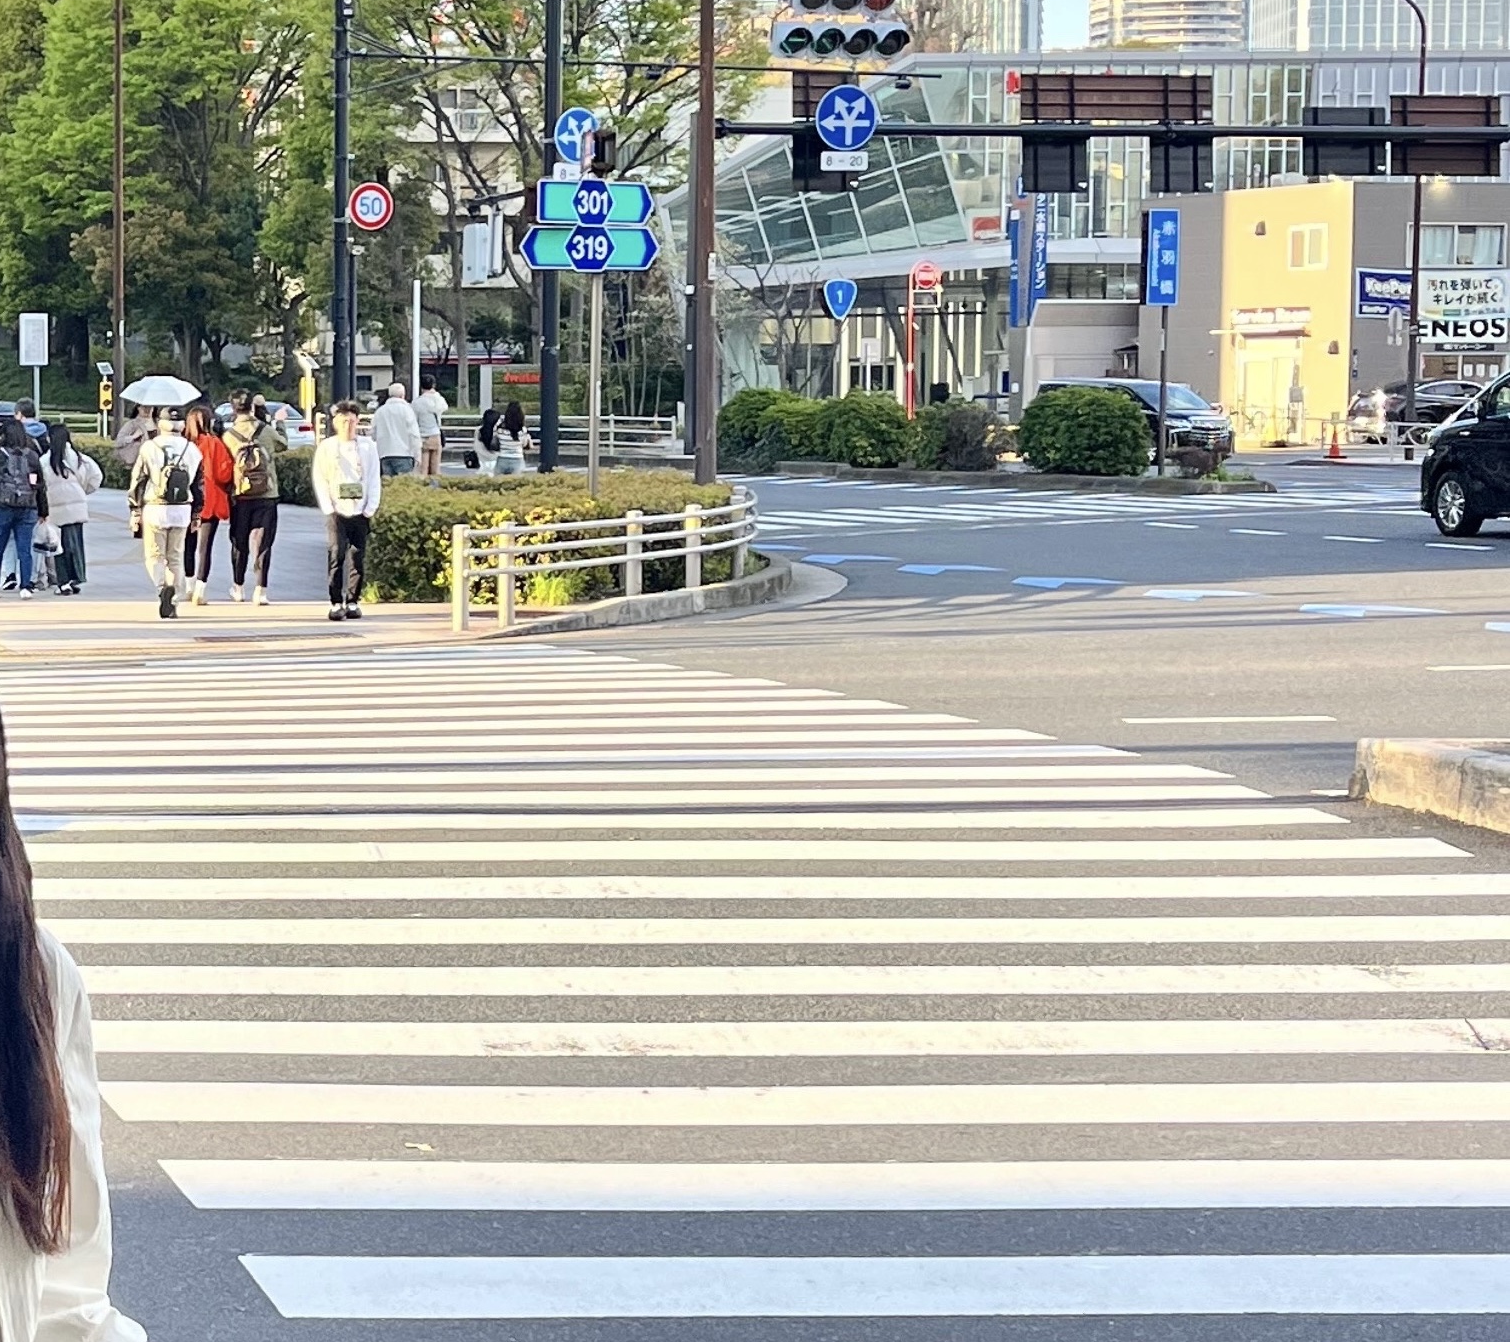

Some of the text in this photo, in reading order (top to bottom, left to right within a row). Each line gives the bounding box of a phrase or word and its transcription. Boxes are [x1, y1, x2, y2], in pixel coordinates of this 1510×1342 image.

[360, 196, 383, 216] 50
[577, 189, 608, 216] 301
[571, 235, 608, 261] 319
[1159, 220, 1177, 295] 赤羽橋
[1418, 318, 1506, 338] ENEOS
